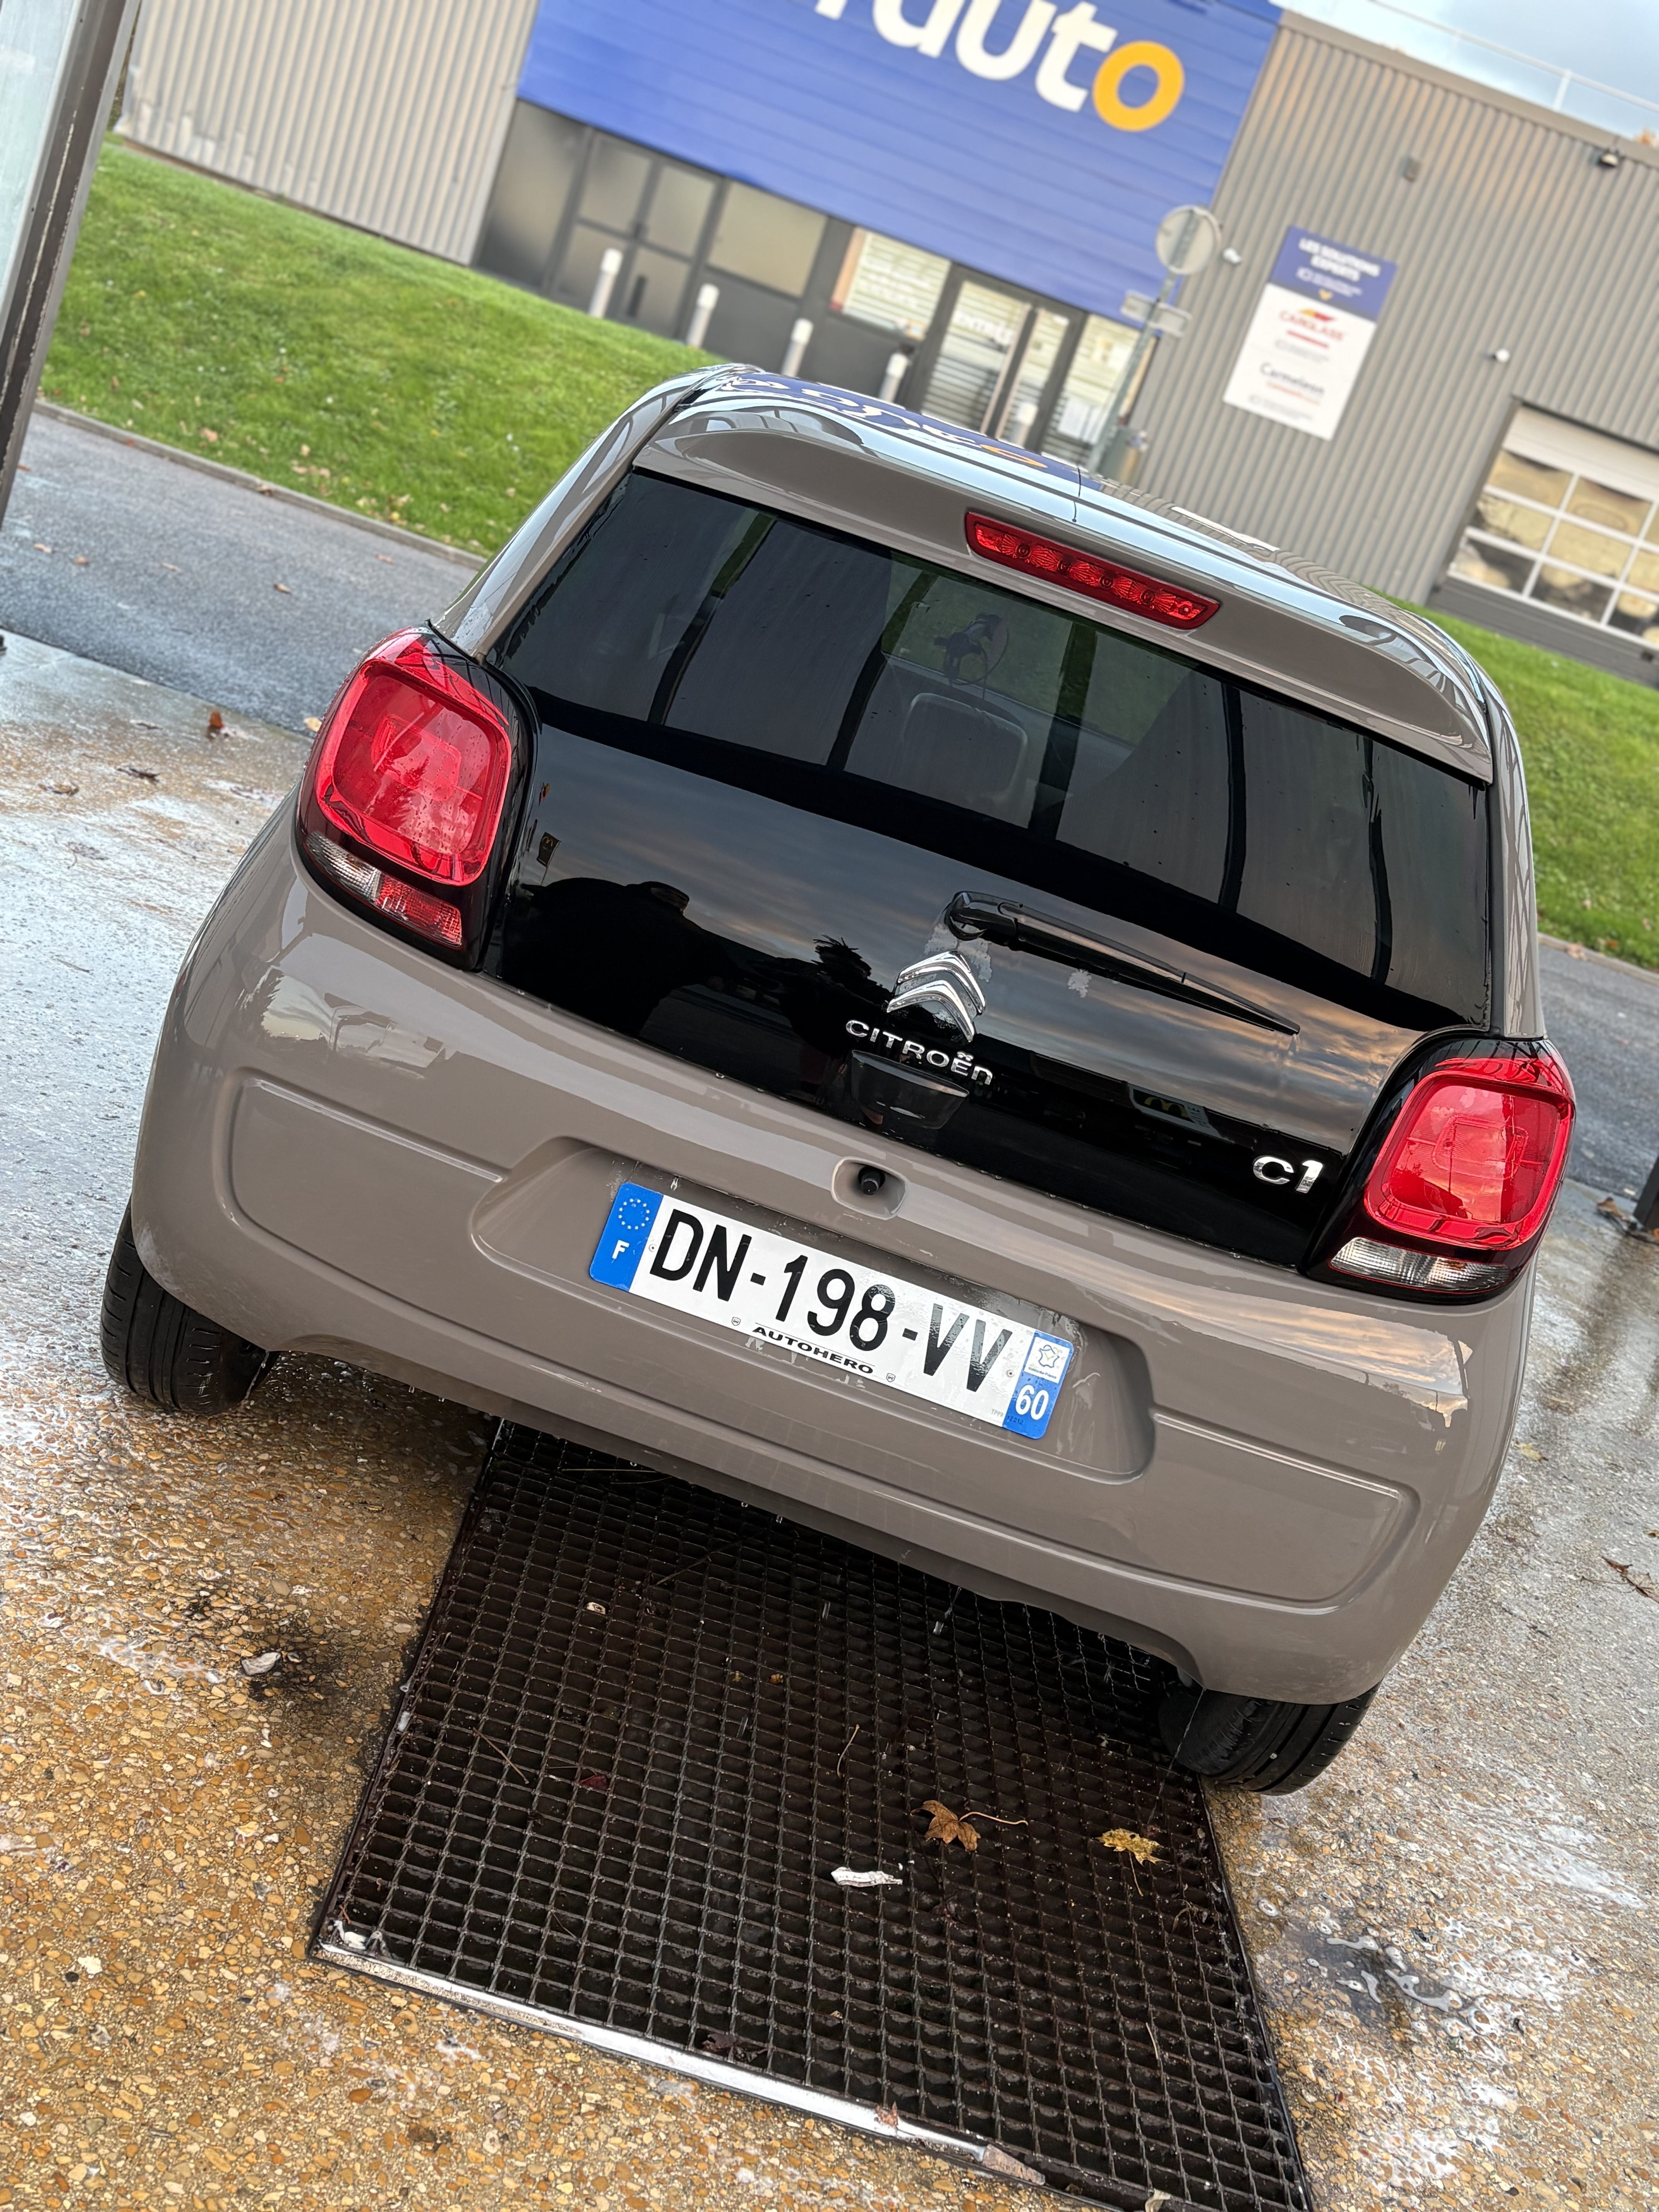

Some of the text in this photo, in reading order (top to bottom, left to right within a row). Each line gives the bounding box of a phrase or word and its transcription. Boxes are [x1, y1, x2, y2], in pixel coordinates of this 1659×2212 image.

[1253, 1156, 1323, 1194] C1
[612, 1240, 630, 1259] F
[650, 1209, 1012, 1392] DN-198-VV
[752, 1327, 873, 1374] AUTOHERO
[1015, 1384, 1049, 1420] 60
